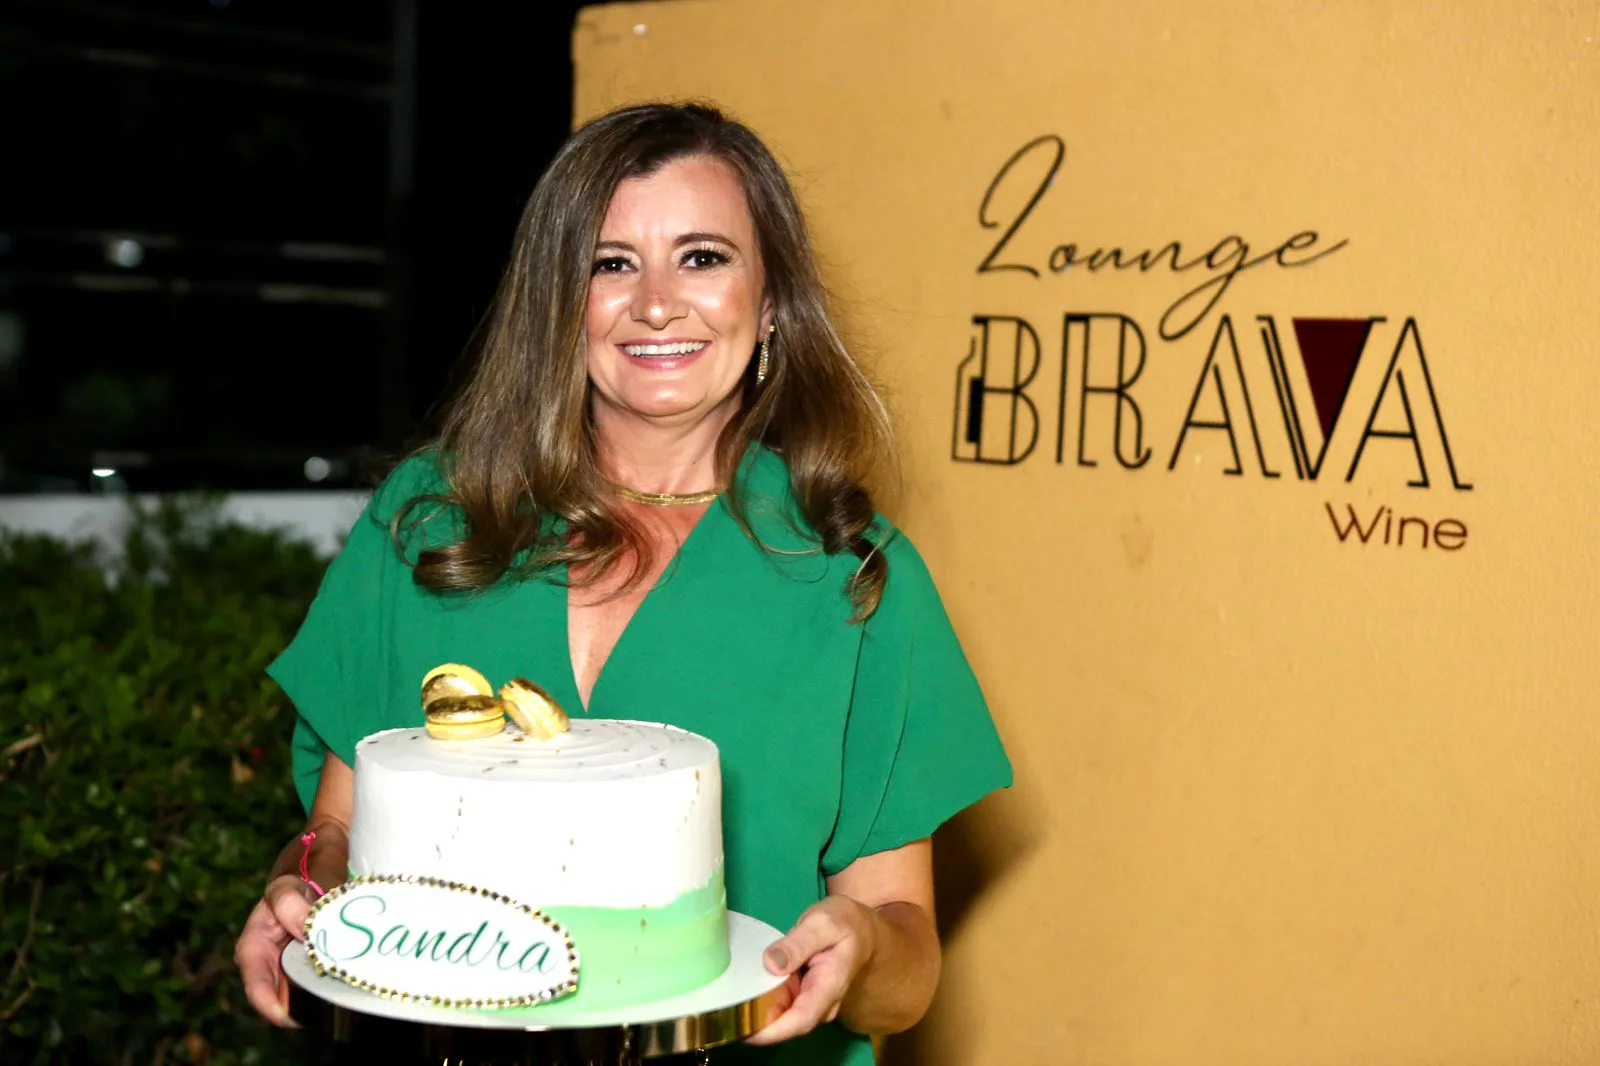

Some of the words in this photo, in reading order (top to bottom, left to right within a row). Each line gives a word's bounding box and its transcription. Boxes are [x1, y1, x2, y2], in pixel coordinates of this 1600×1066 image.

[976, 134, 1350, 342] Lounge
[951, 312, 1474, 491] BRAVA
[1324, 501, 1468, 551] Wine
[316, 895, 558, 974] Sandra
